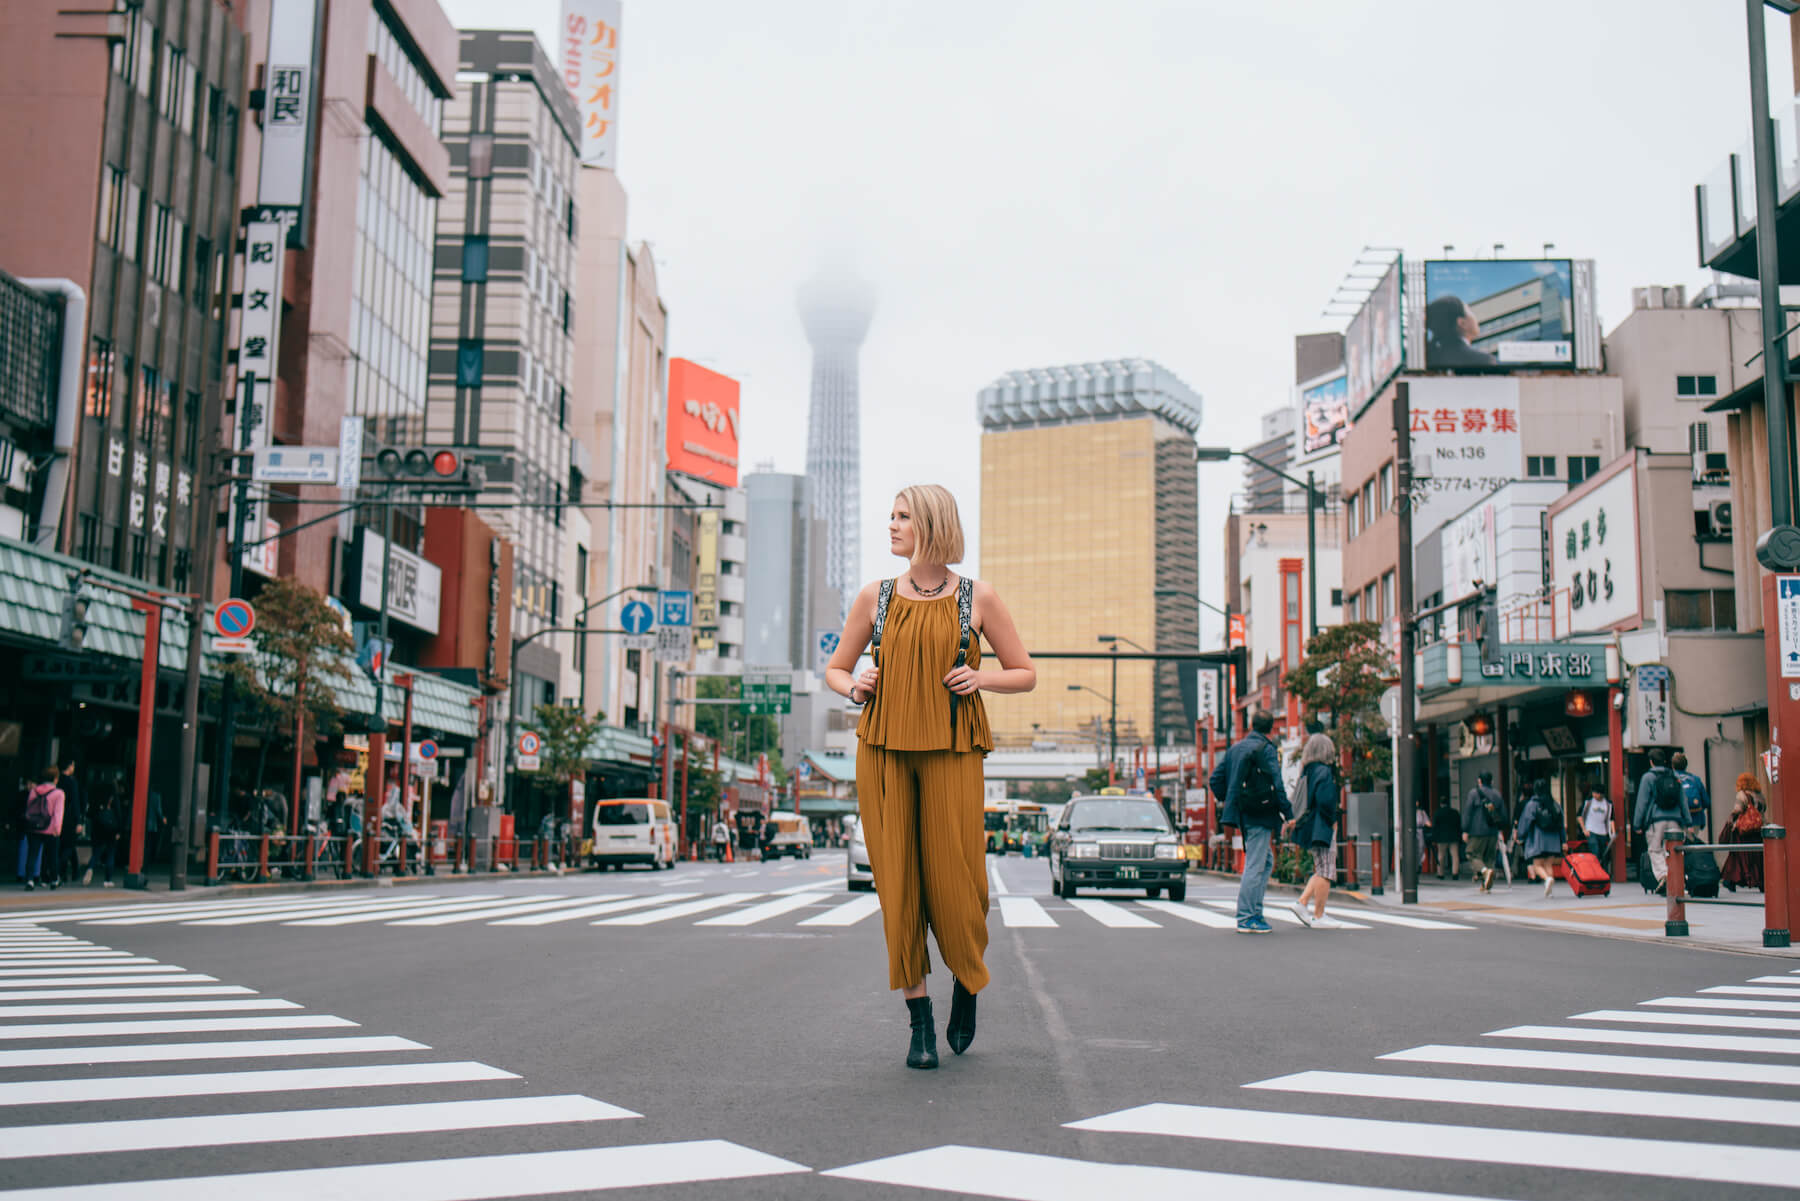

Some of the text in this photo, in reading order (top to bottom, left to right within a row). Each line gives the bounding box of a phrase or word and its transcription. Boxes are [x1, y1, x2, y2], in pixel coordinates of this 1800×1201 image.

[565, 12, 587, 105] SHID
[588, 20, 617, 139] カラオケ
[273, 69, 302, 121] 和民
[1409, 408, 1518, 433] 広告募集
[1436, 447, 1486, 459] No.136
